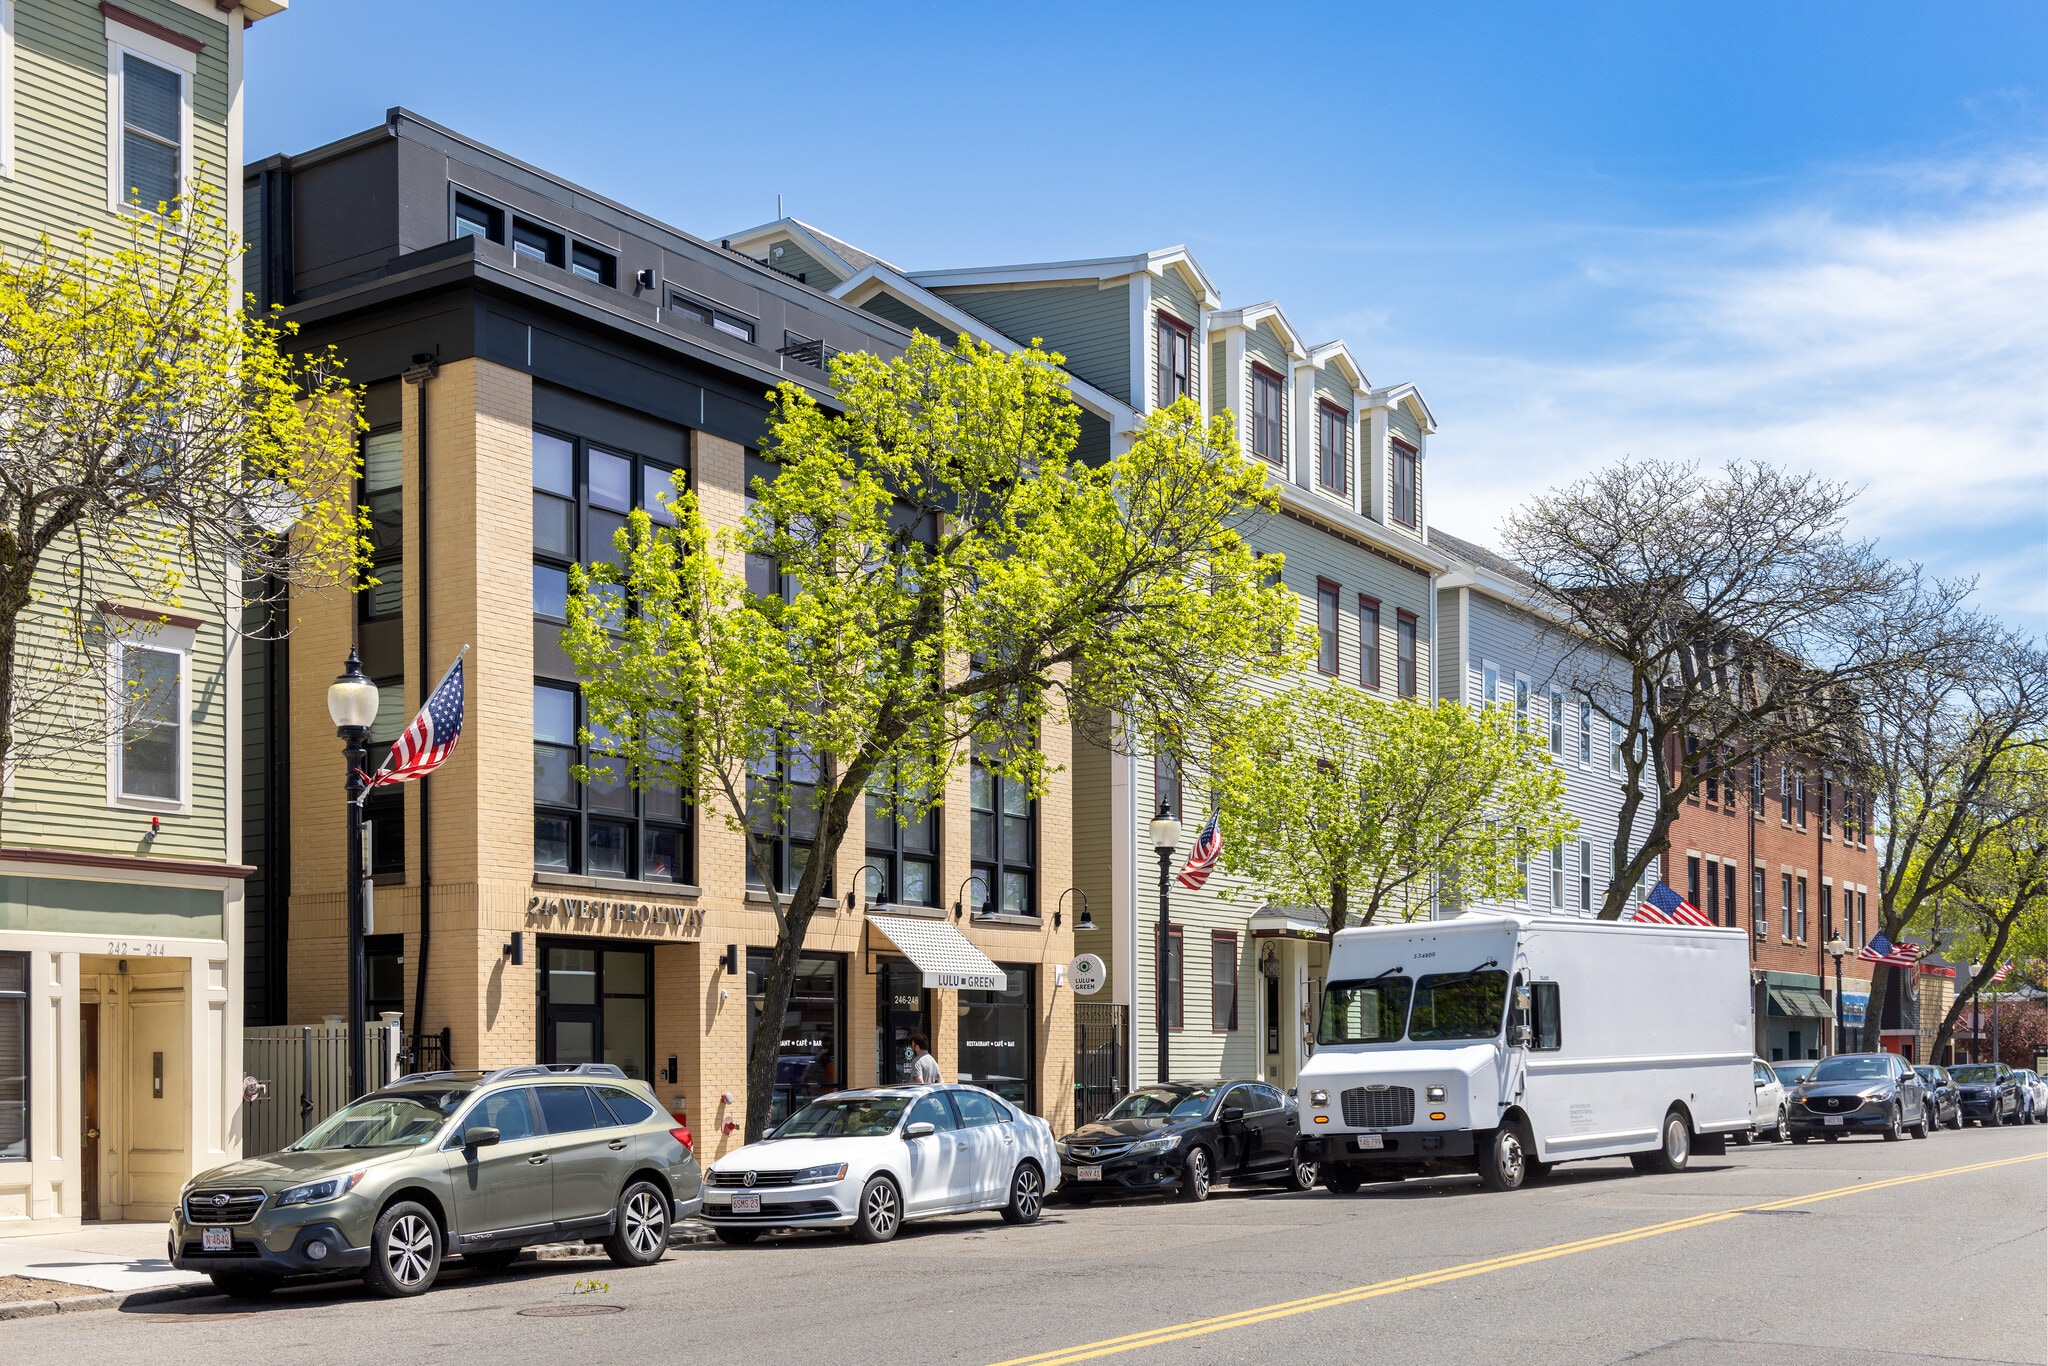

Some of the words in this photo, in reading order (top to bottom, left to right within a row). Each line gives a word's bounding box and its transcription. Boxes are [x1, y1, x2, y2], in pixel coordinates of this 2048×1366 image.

[529, 896, 558, 916] 246
[562, 898, 612, 920] WEST
[614, 903, 706, 927] BROADWAY
[108, 942, 127, 955] 242
[146, 943, 165, 956] 244
[938, 975, 959, 986] LULU
[967, 976, 995, 988] GREEN
[894, 995, 919, 1004] 246-248
[796, 1038, 807, 1047] CAFÉ
[812, 1039, 822, 1047] BAR
[733, 1199, 749, 1209] 6SMS
[750, 1199, 759, 1209] 23
